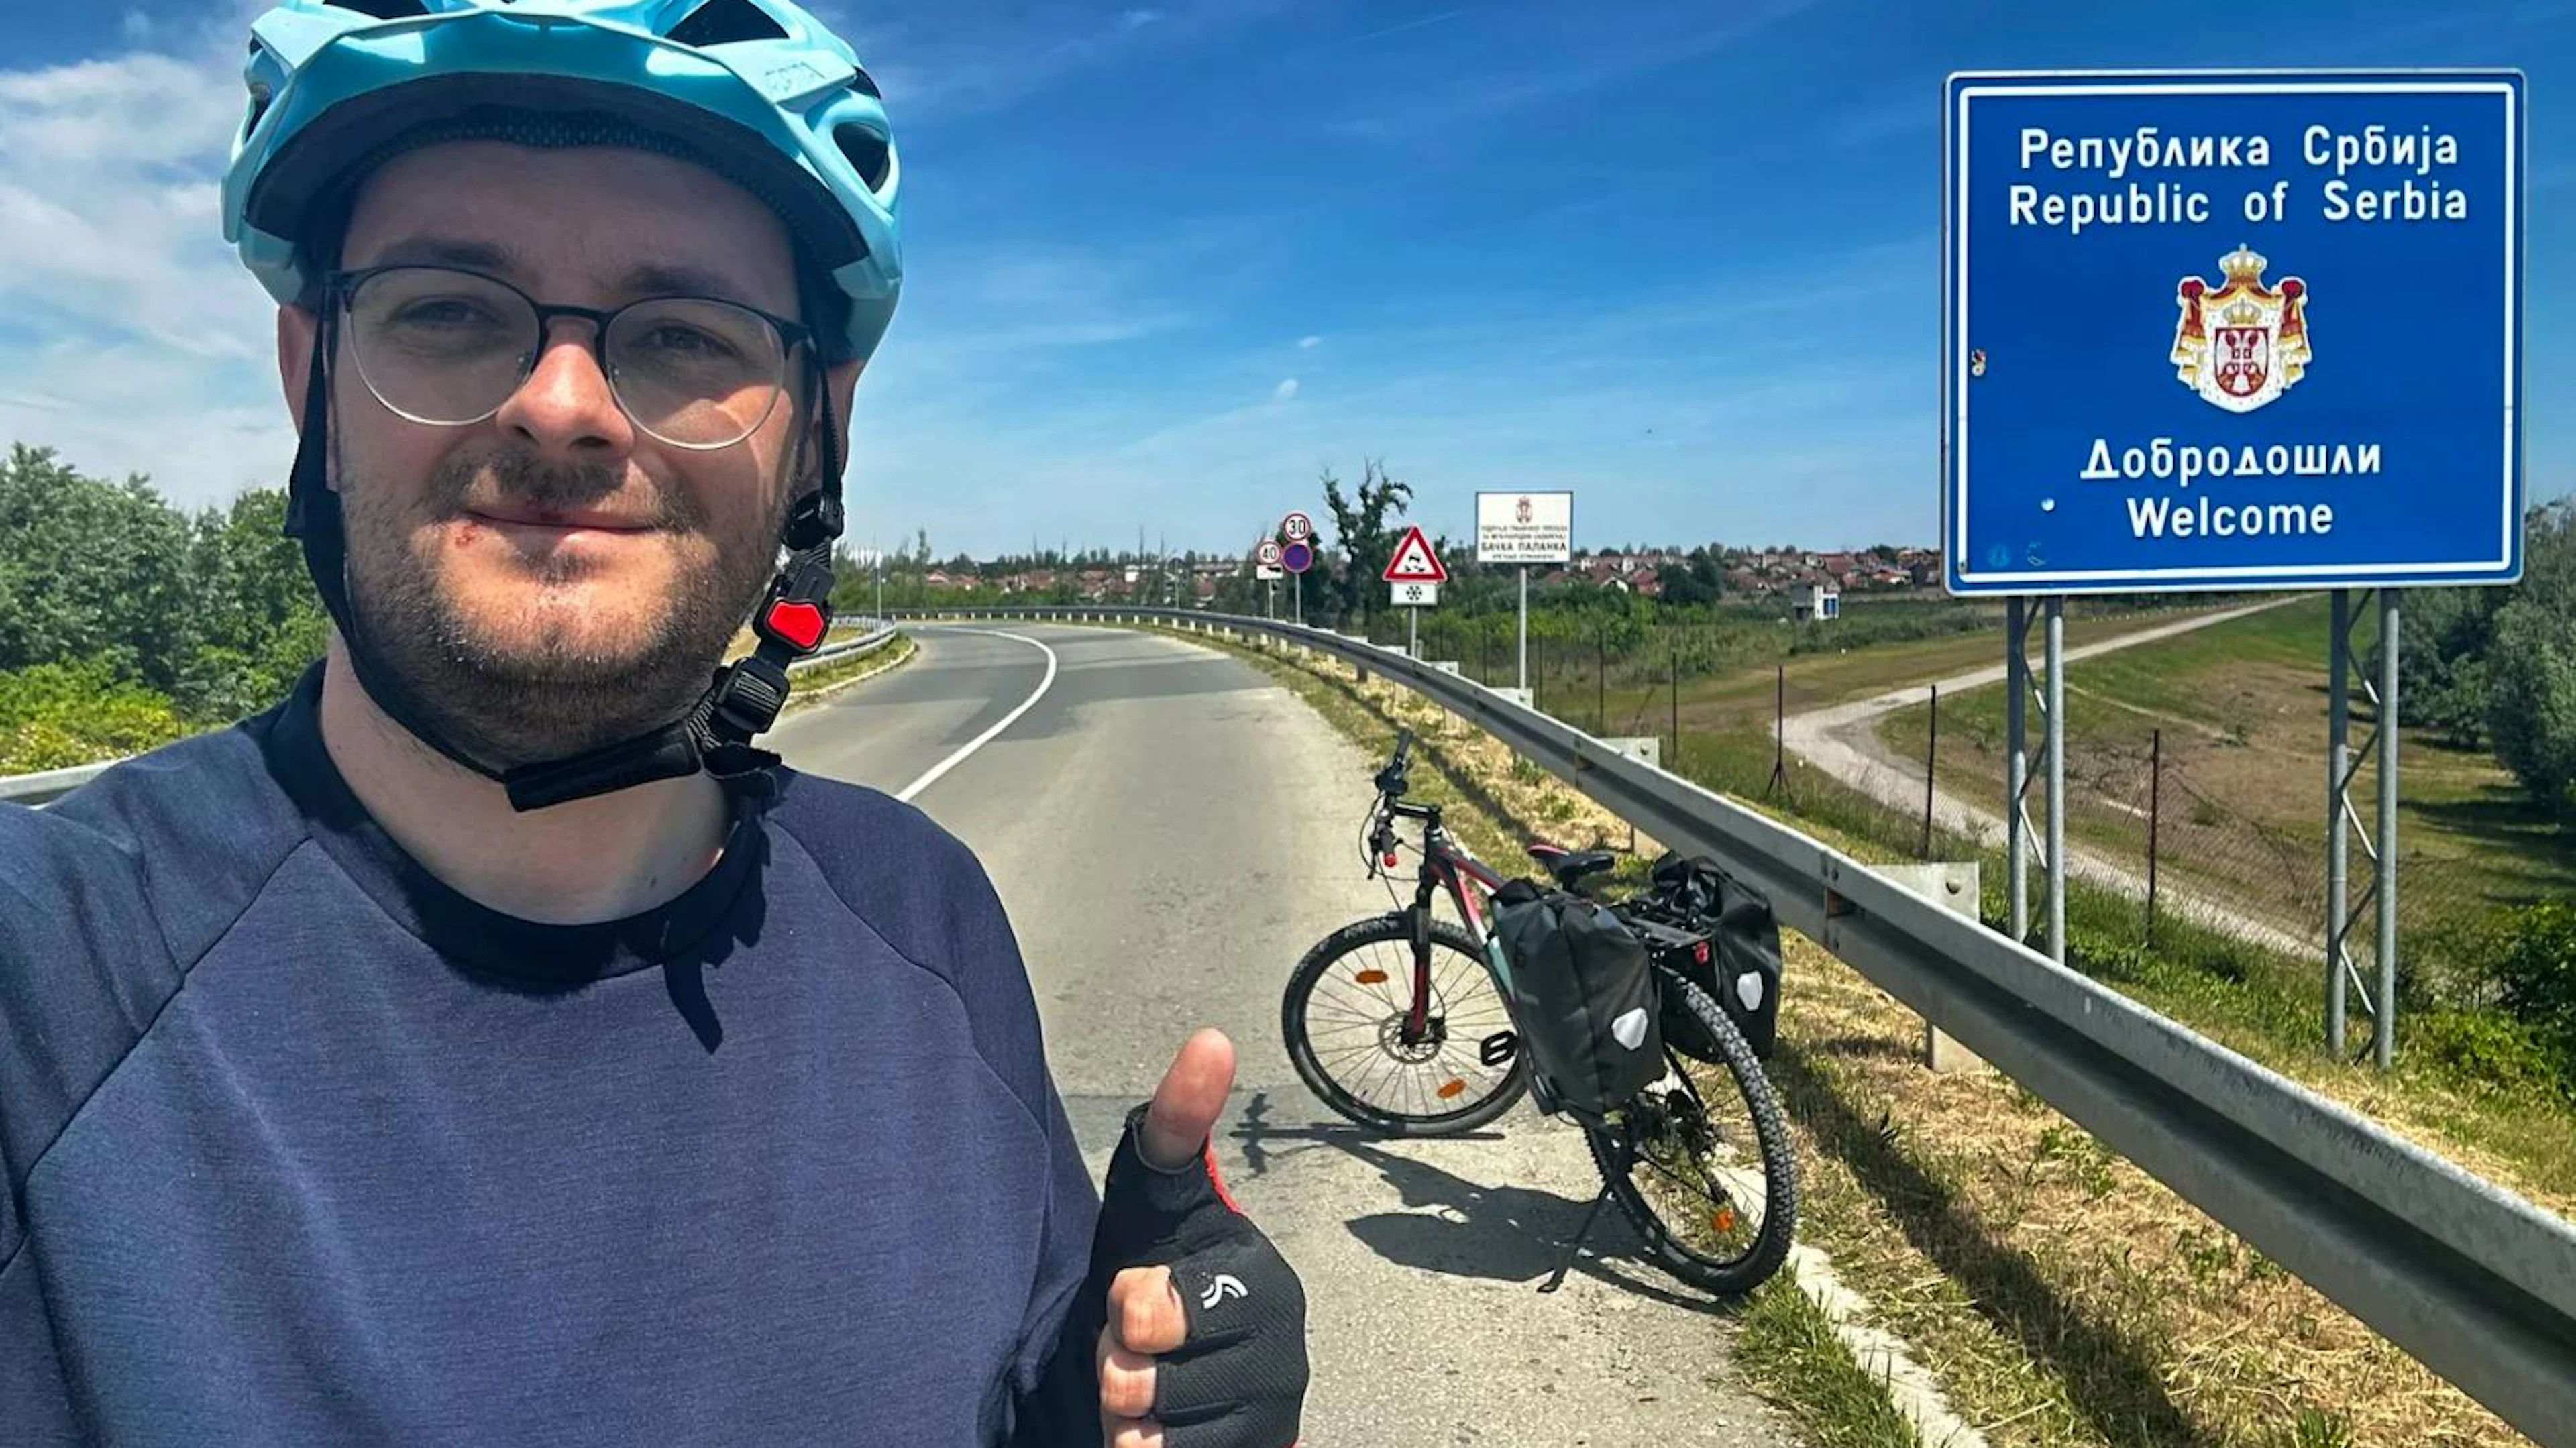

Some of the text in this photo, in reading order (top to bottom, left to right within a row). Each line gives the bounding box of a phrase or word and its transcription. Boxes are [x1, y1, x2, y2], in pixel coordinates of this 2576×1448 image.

[2021, 125, 2457, 178] Република Србија
[2010, 180, 2467, 235] Republic of Serbia
[2080, 437, 2380, 487] Добродошли
[1289, 519, 1306, 535] 30
[2127, 496, 2333, 537] Welcome
[1263, 546, 1276, 559] 40
